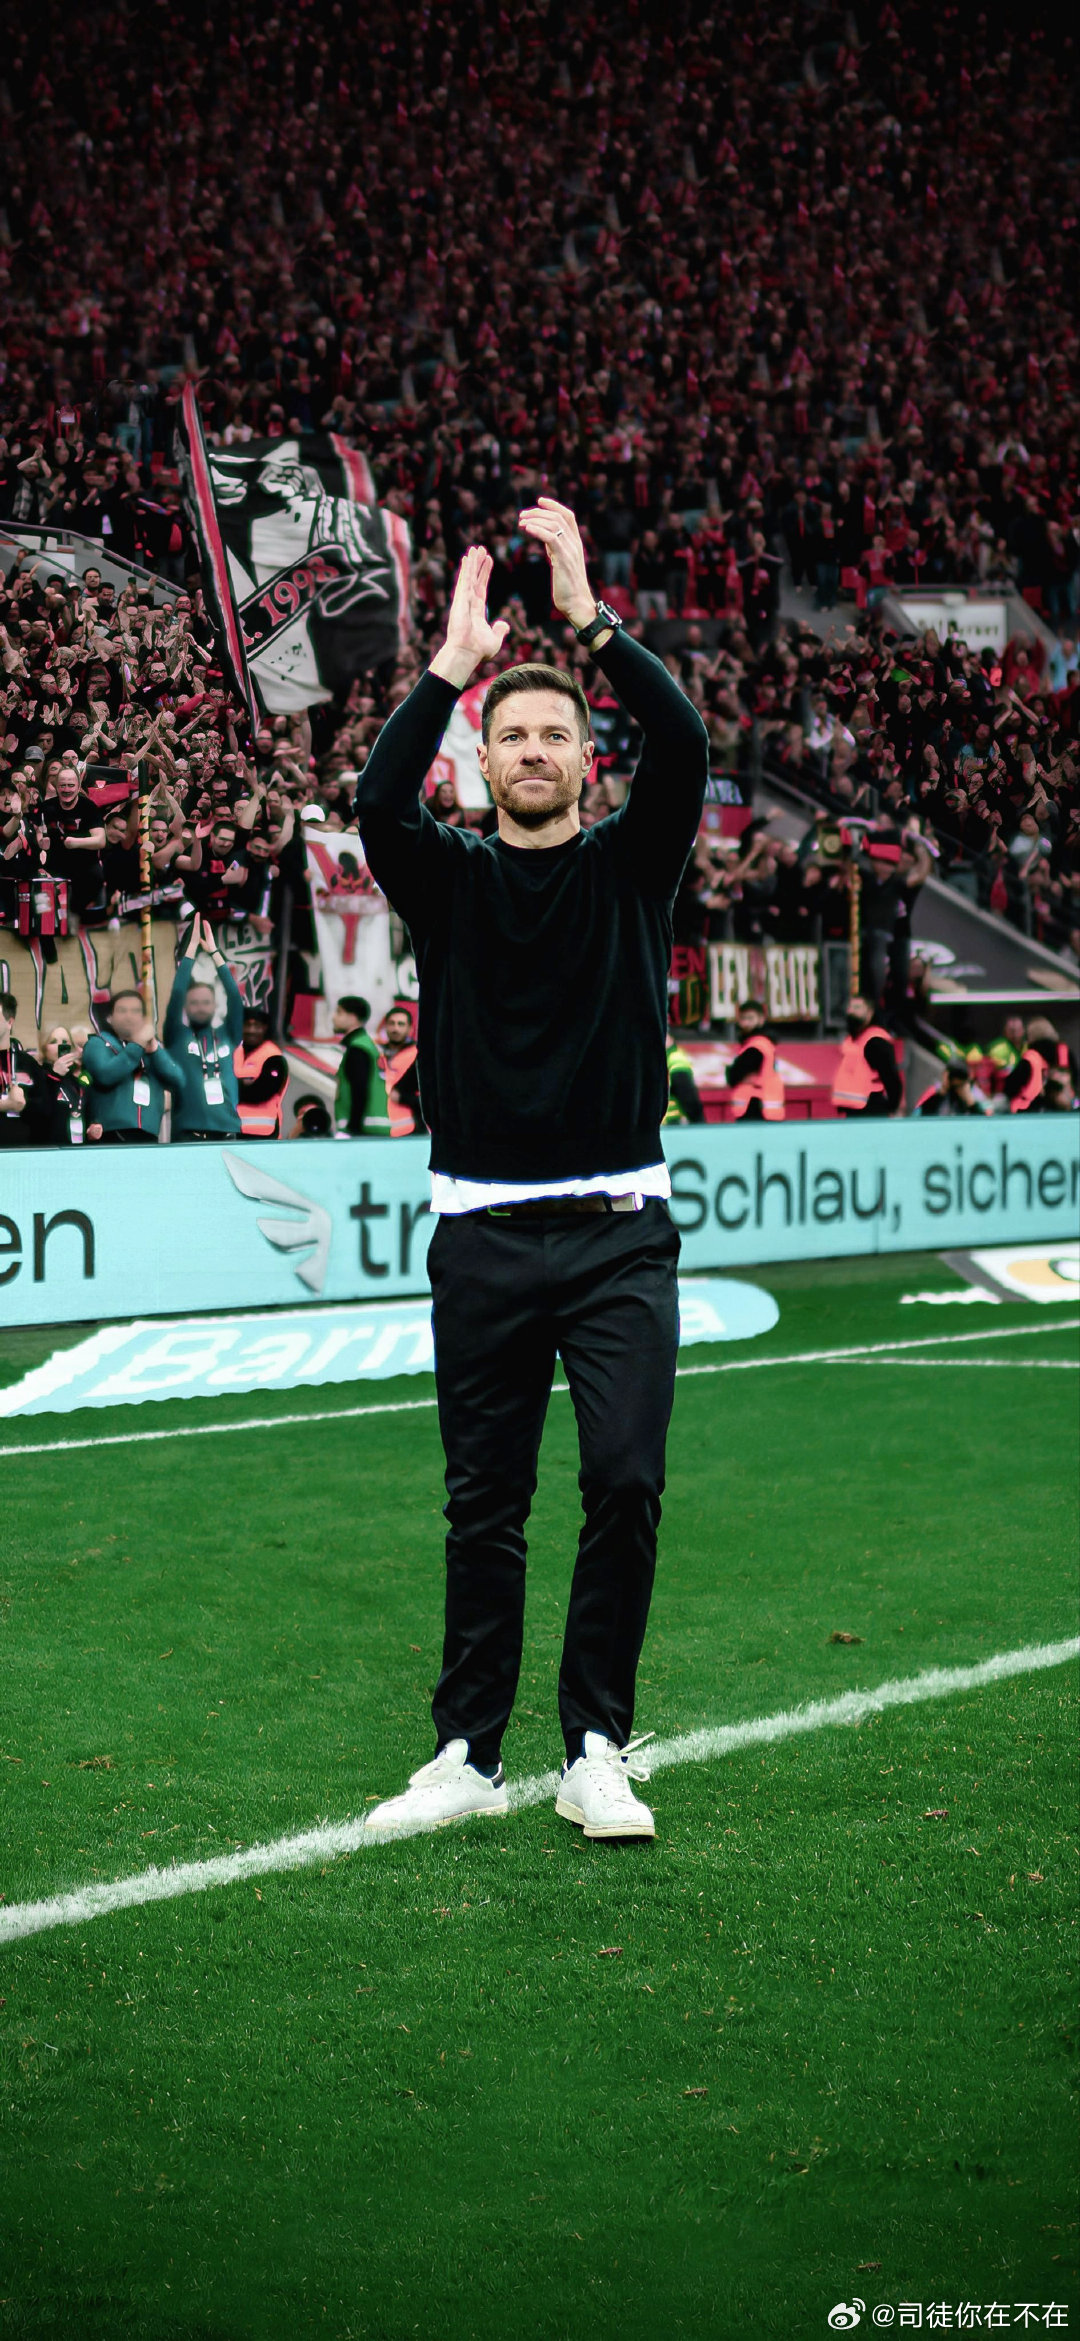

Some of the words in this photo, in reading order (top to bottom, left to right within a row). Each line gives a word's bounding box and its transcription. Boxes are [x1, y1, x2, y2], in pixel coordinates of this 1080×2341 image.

[259, 556, 340, 627] 1998
[767, 946, 820, 1019] ELITE
[671, 1149, 900, 1232] Schlau,
